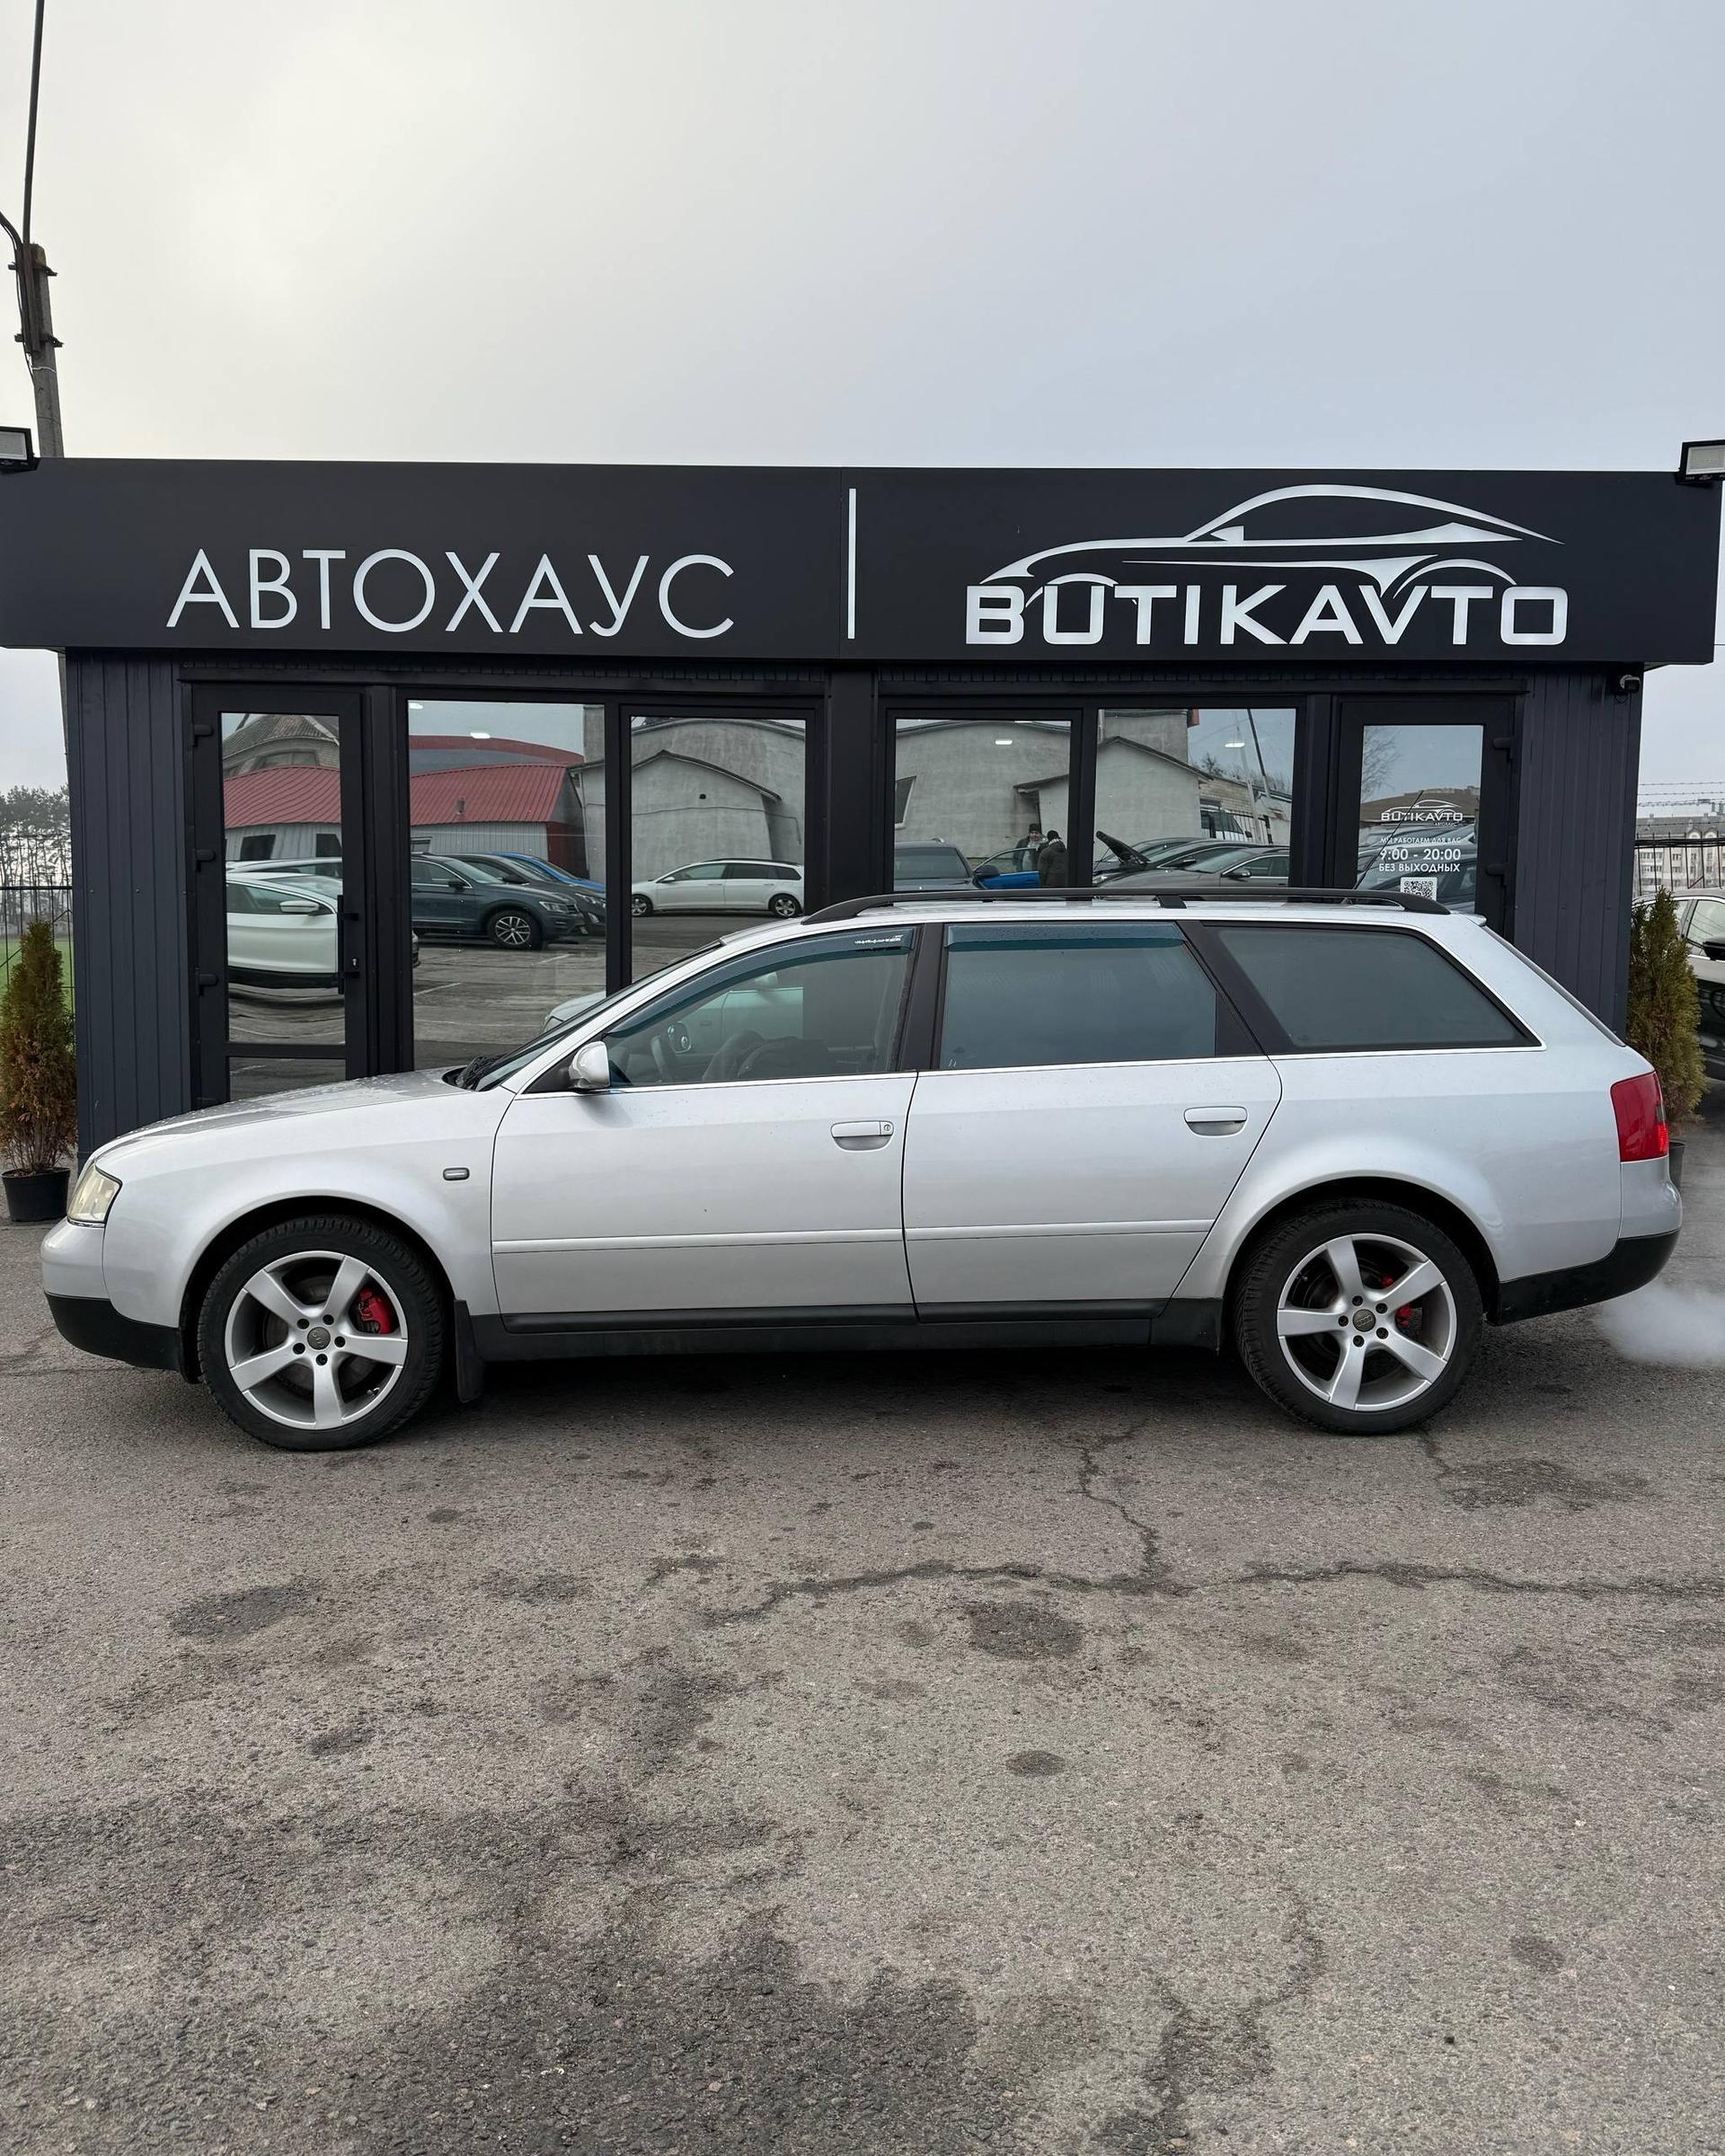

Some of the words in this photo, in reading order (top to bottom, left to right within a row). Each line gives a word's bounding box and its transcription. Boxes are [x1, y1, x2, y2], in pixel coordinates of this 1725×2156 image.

[166, 548, 734, 639] АВТОХАУС
[965, 585, 1569, 646] BUTIKAVTO
[1381, 812, 1463, 821] BUTIKAVTO
[1380, 849, 1408, 860] 9:00
[1423, 848, 1461, 860] 20:00
[1379, 863, 1395, 871] БЕЗ
[1399, 863, 1460, 872] ВЫХОДНЫХ
